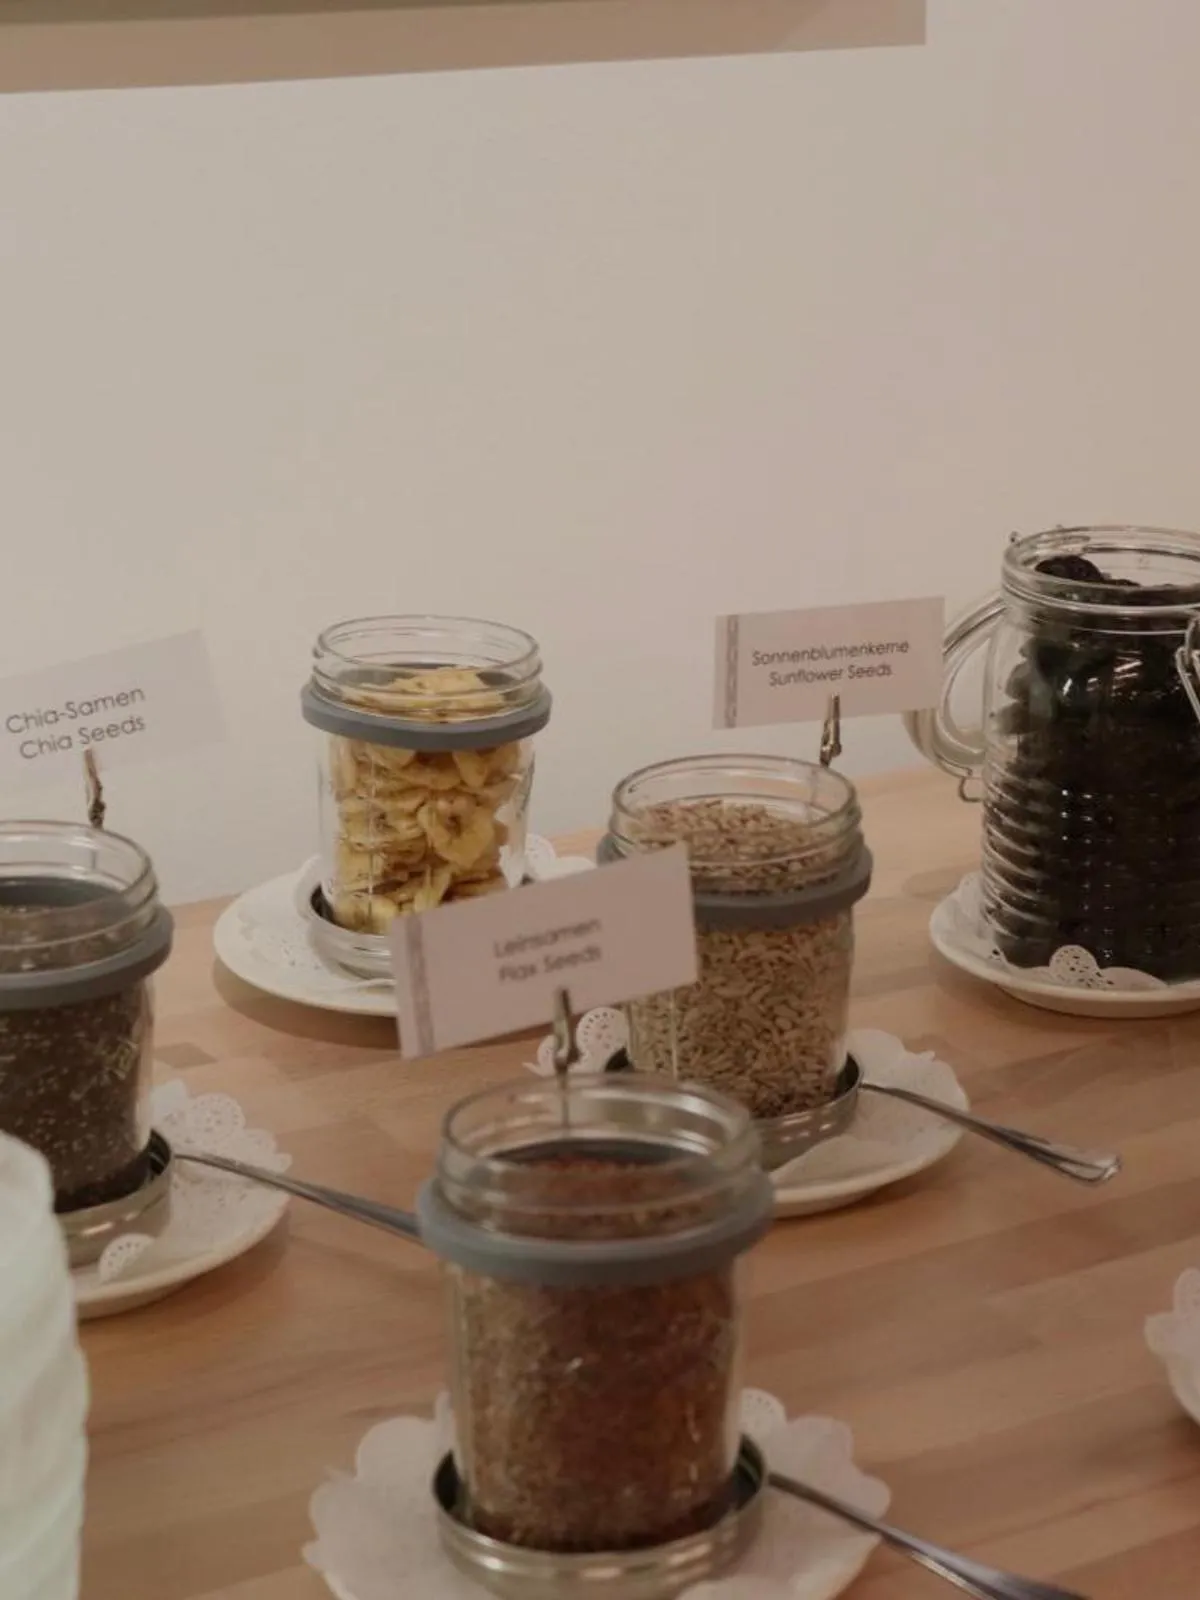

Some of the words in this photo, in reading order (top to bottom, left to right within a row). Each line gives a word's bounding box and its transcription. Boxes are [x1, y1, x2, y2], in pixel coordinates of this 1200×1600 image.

[752, 640, 909, 667] Sonnenblumenkerne
[768, 667, 844, 688] Sunflower
[848, 662, 894, 680] Seeds
[5, 687, 146, 734] Chia-Samen
[19, 733, 73, 760] Chia
[77, 714, 147, 745] Seeds
[493, 917, 601, 959] Leinsamen
[499, 962, 537, 983] Flax
[543, 946, 601, 974] Seeds
